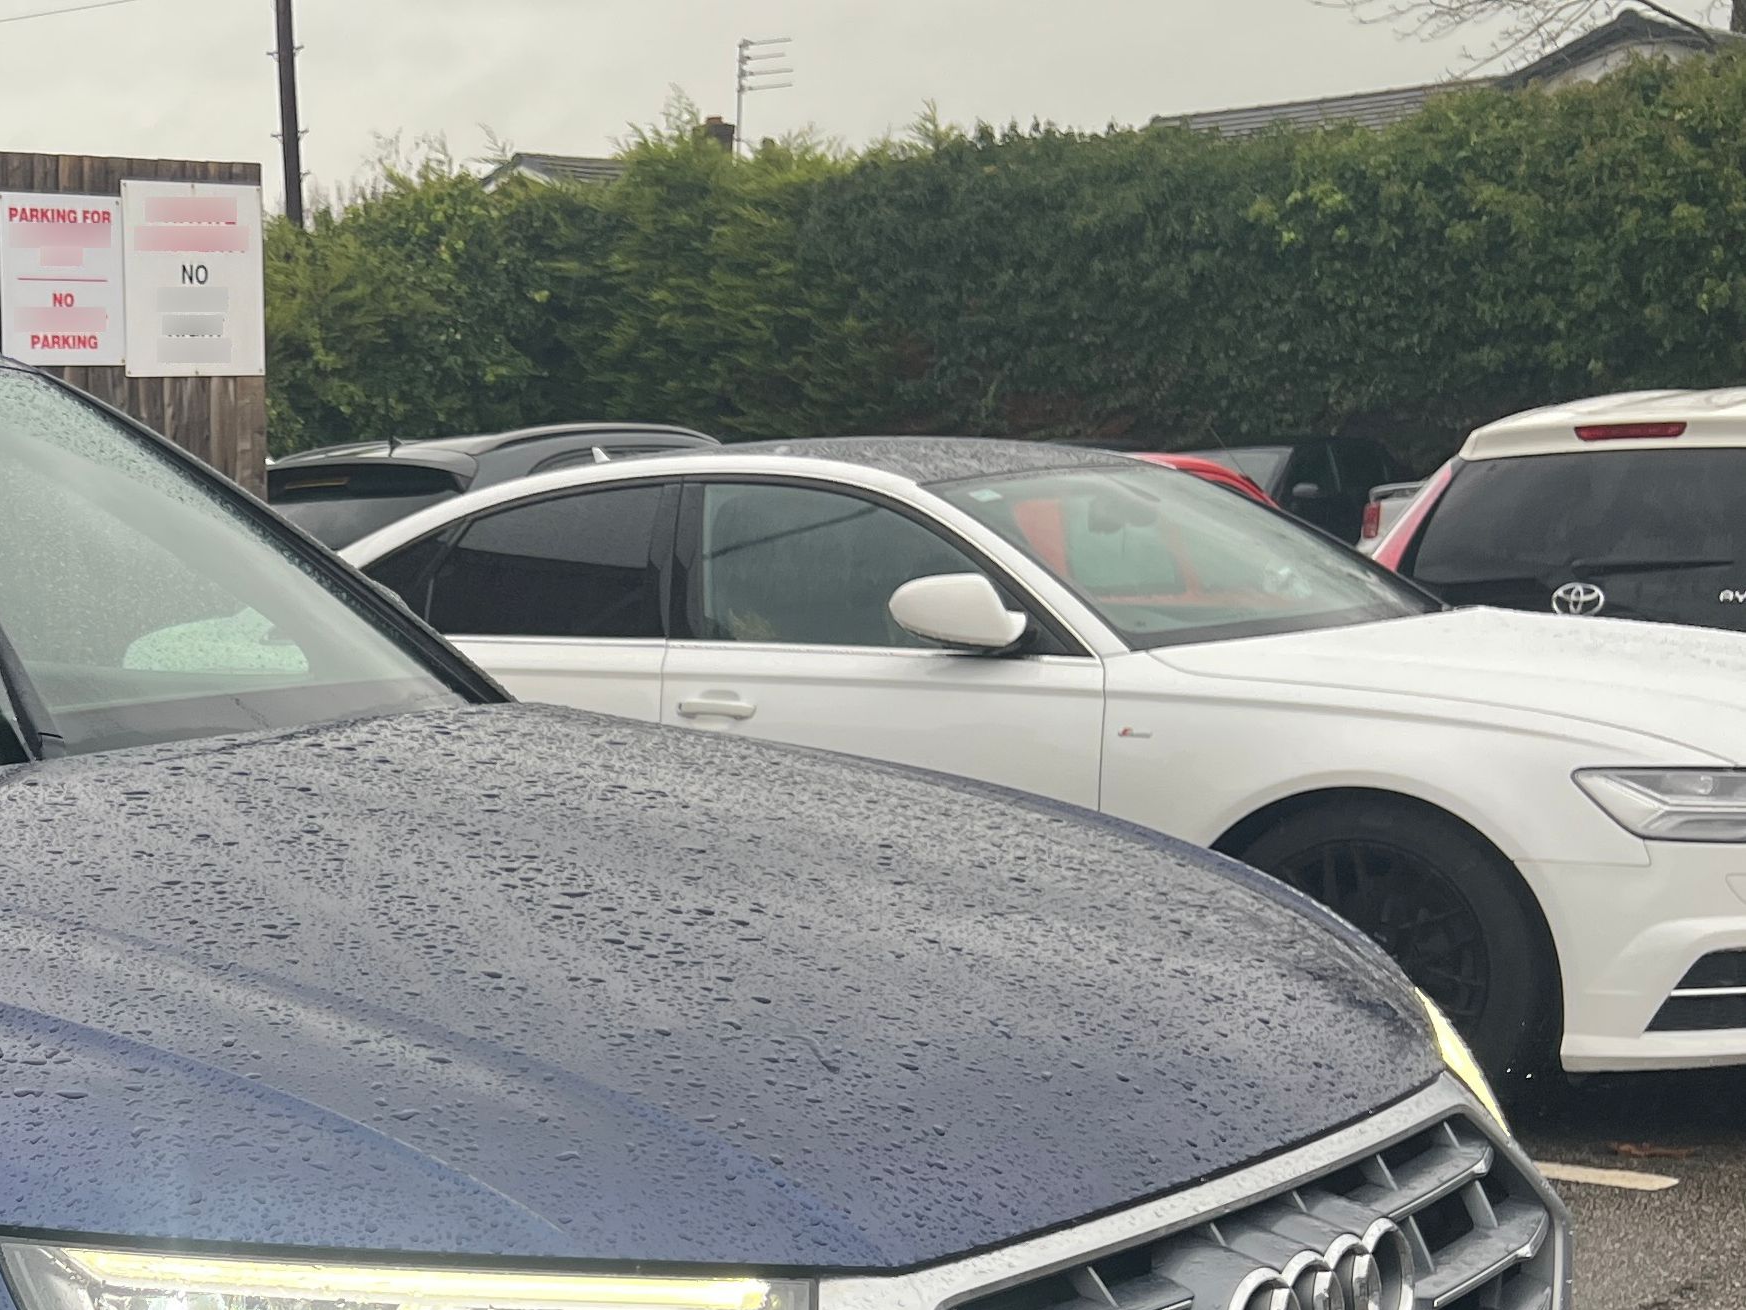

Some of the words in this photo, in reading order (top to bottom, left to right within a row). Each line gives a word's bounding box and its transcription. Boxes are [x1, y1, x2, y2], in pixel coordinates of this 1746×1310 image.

[8, 207, 78, 223] PARKING
[82, 210, 112, 224] FOR
[181, 264, 209, 285] NO
[52, 293, 74, 308] NO
[30, 335, 98, 349] PARKING
